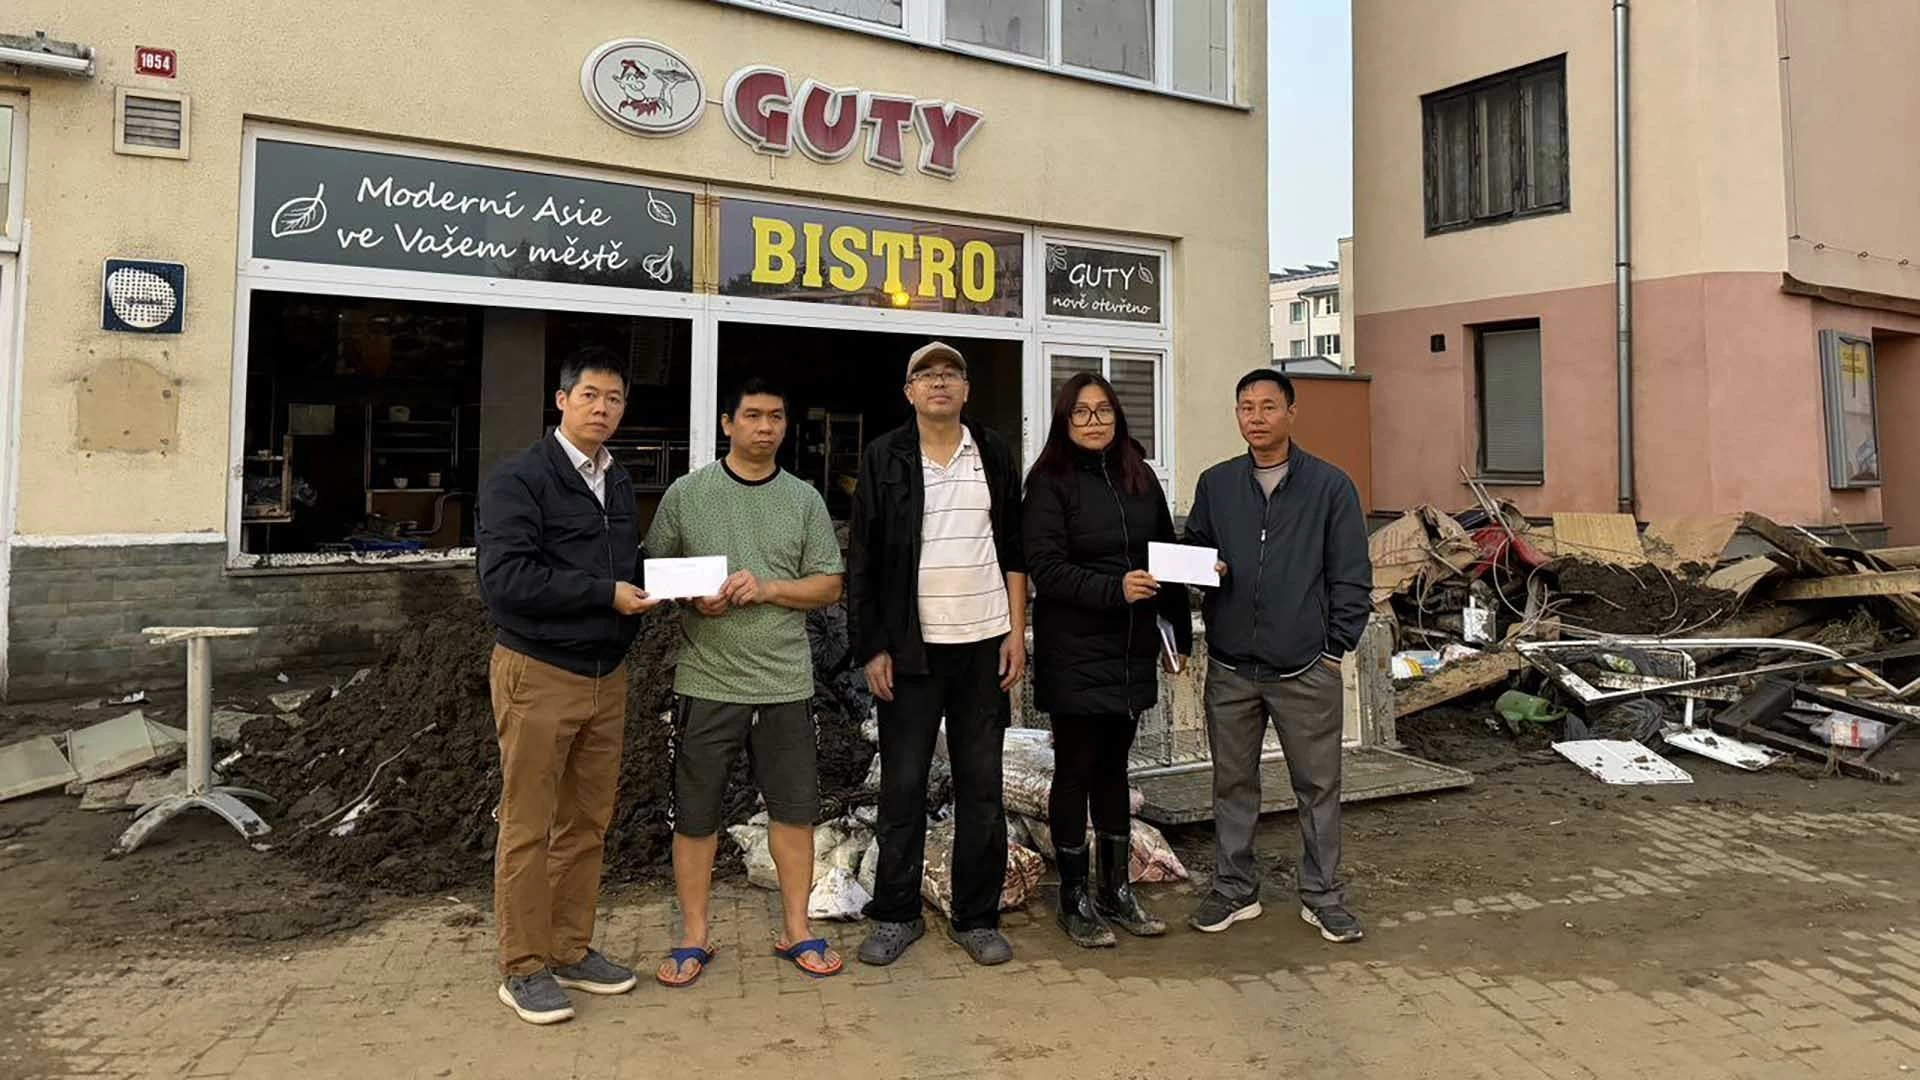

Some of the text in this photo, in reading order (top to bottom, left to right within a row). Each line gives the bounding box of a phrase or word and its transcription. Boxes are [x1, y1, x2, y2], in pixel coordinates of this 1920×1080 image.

[140, 53, 170, 71] 1054
[726, 67, 983, 178] GUTY
[357, 176, 612, 227] Moderní Asie
[336, 223, 629, 271] ve Vašem městě
[751, 215, 996, 303] BISTRO
[1068, 263, 1136, 291] GUTY
[1052, 292, 1153, 315] nově otevřeno
